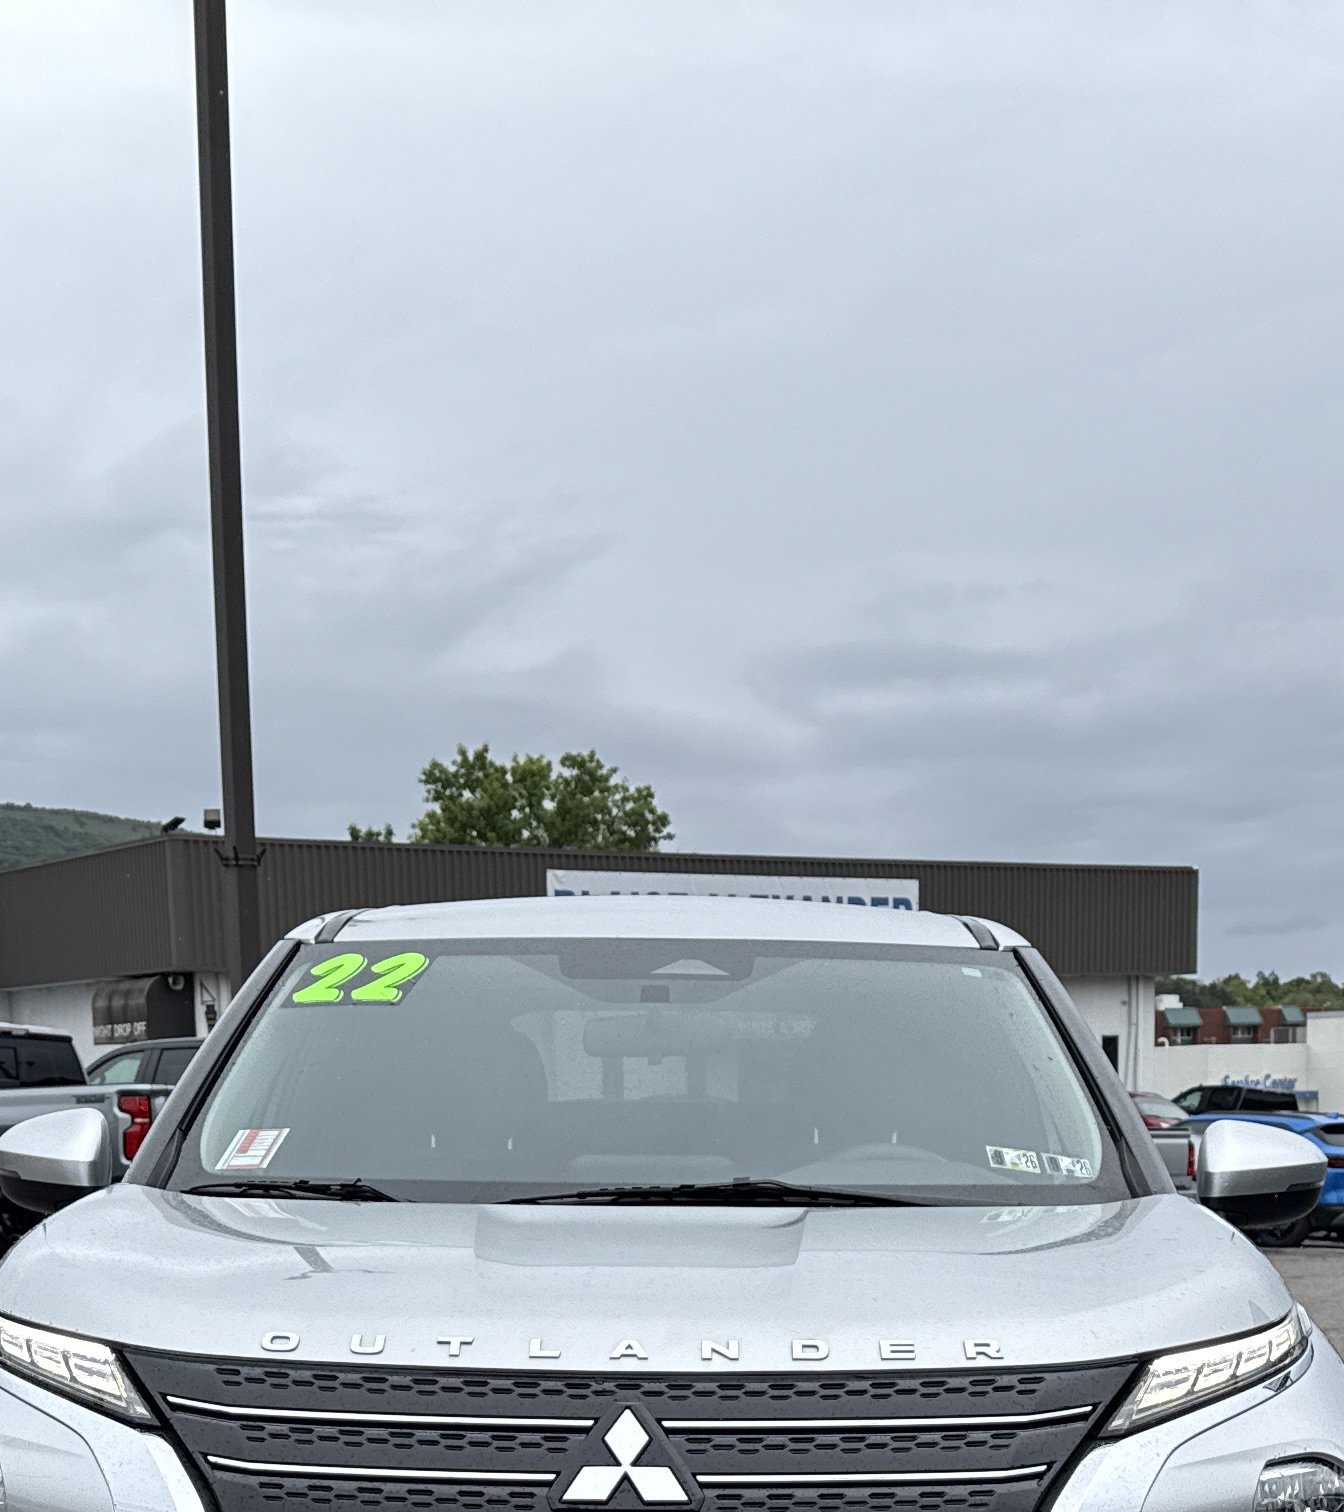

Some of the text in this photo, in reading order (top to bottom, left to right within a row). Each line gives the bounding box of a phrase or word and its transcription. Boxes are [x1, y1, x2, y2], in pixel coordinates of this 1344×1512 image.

[292, 952, 430, 1004] 22
[113, 1021, 133, 1037] DROP
[259, 1330, 1006, 1362] OUTLANDER
